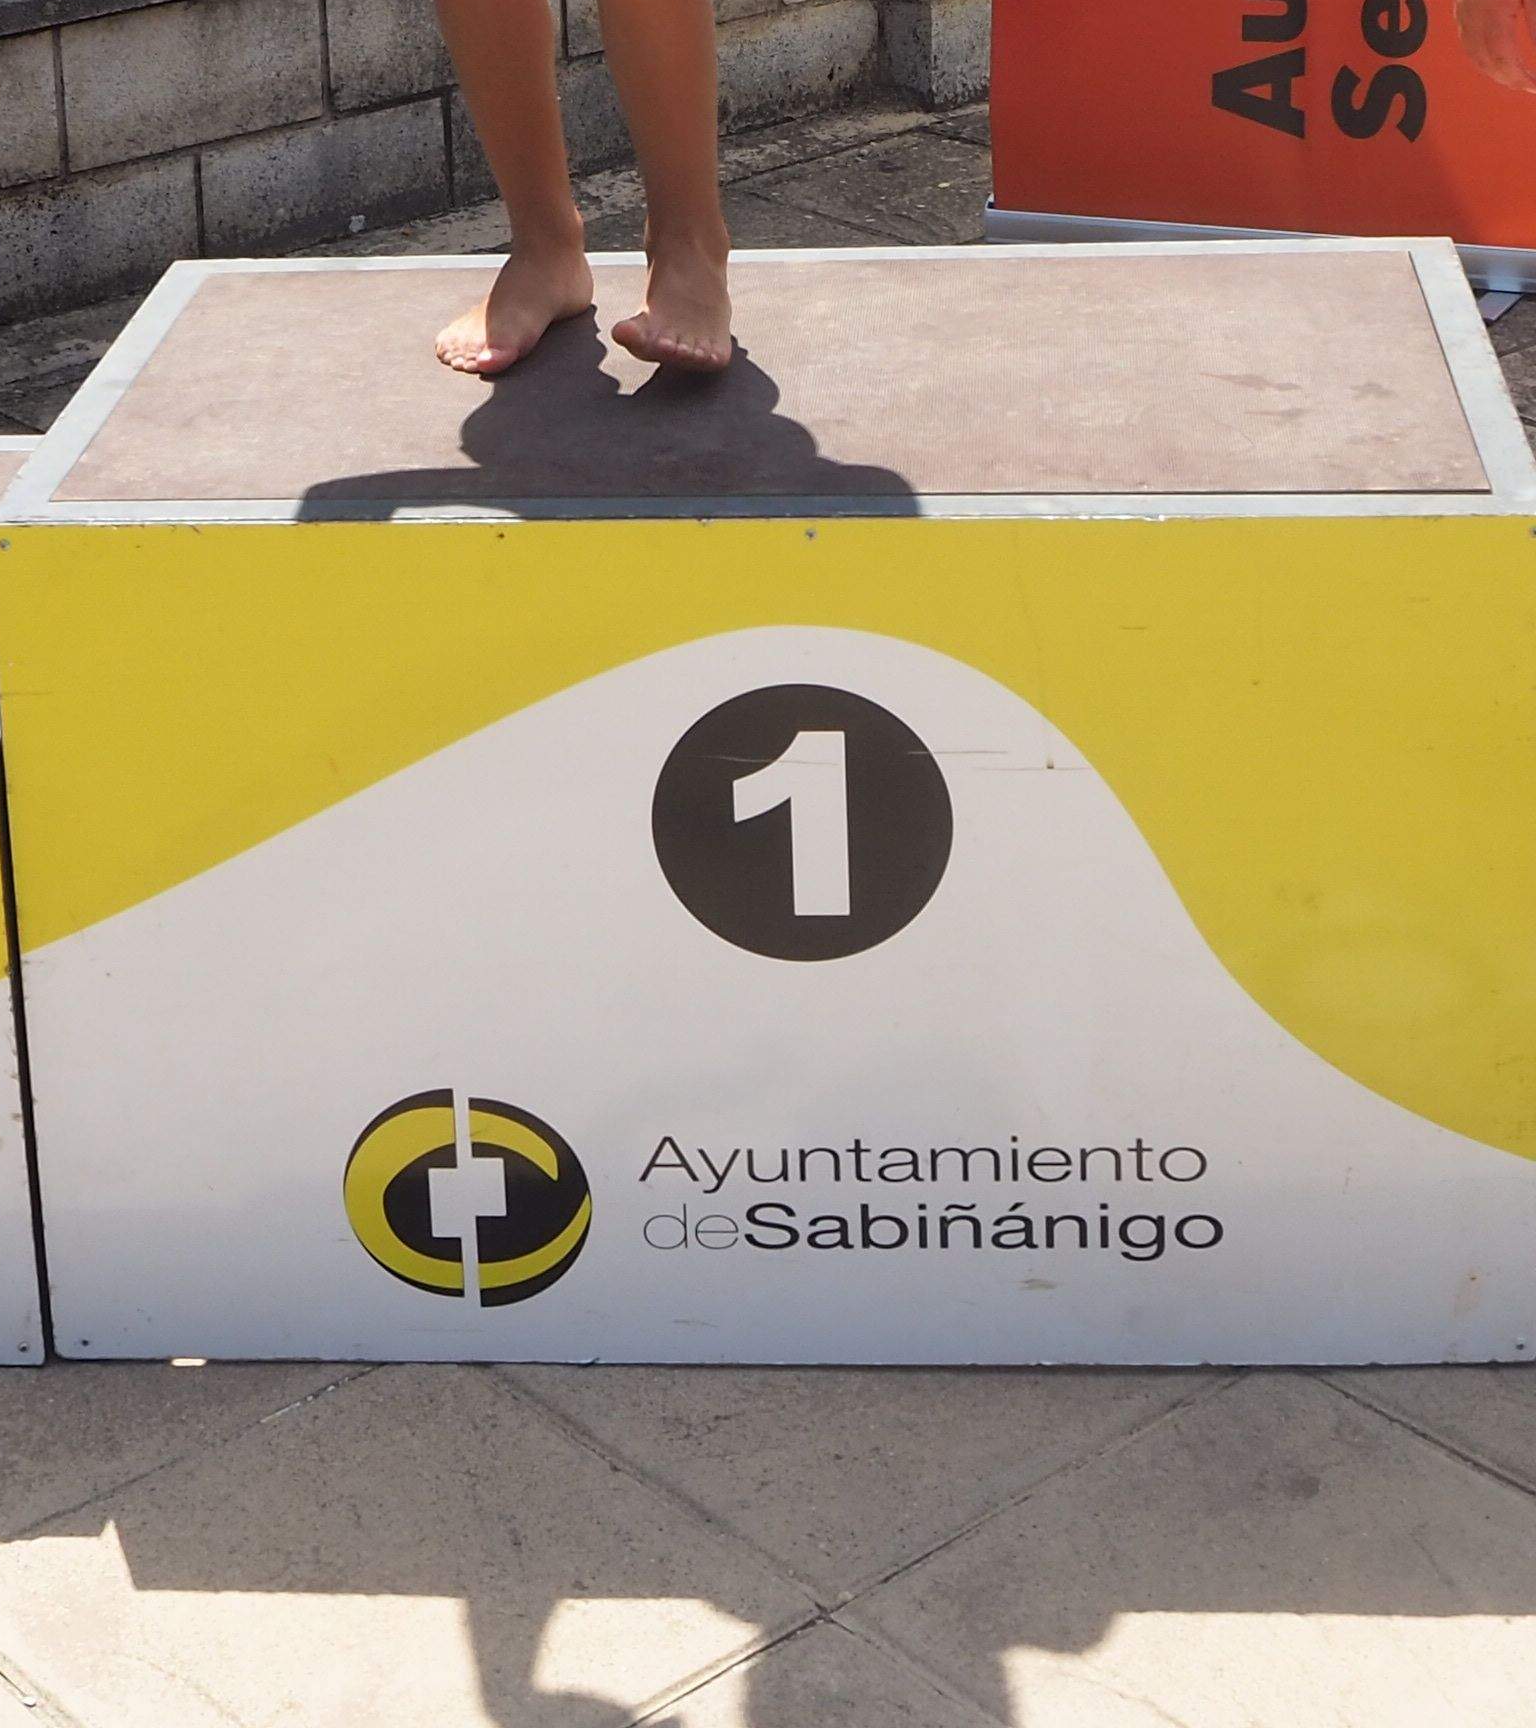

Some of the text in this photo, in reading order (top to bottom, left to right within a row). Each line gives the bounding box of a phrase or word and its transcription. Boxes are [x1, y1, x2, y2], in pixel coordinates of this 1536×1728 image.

[732, 730, 851, 916] 1
[638, 1135, 1208, 1194] Ayuntamiento
[643, 1201, 1224, 1262] deSabiñánigo
